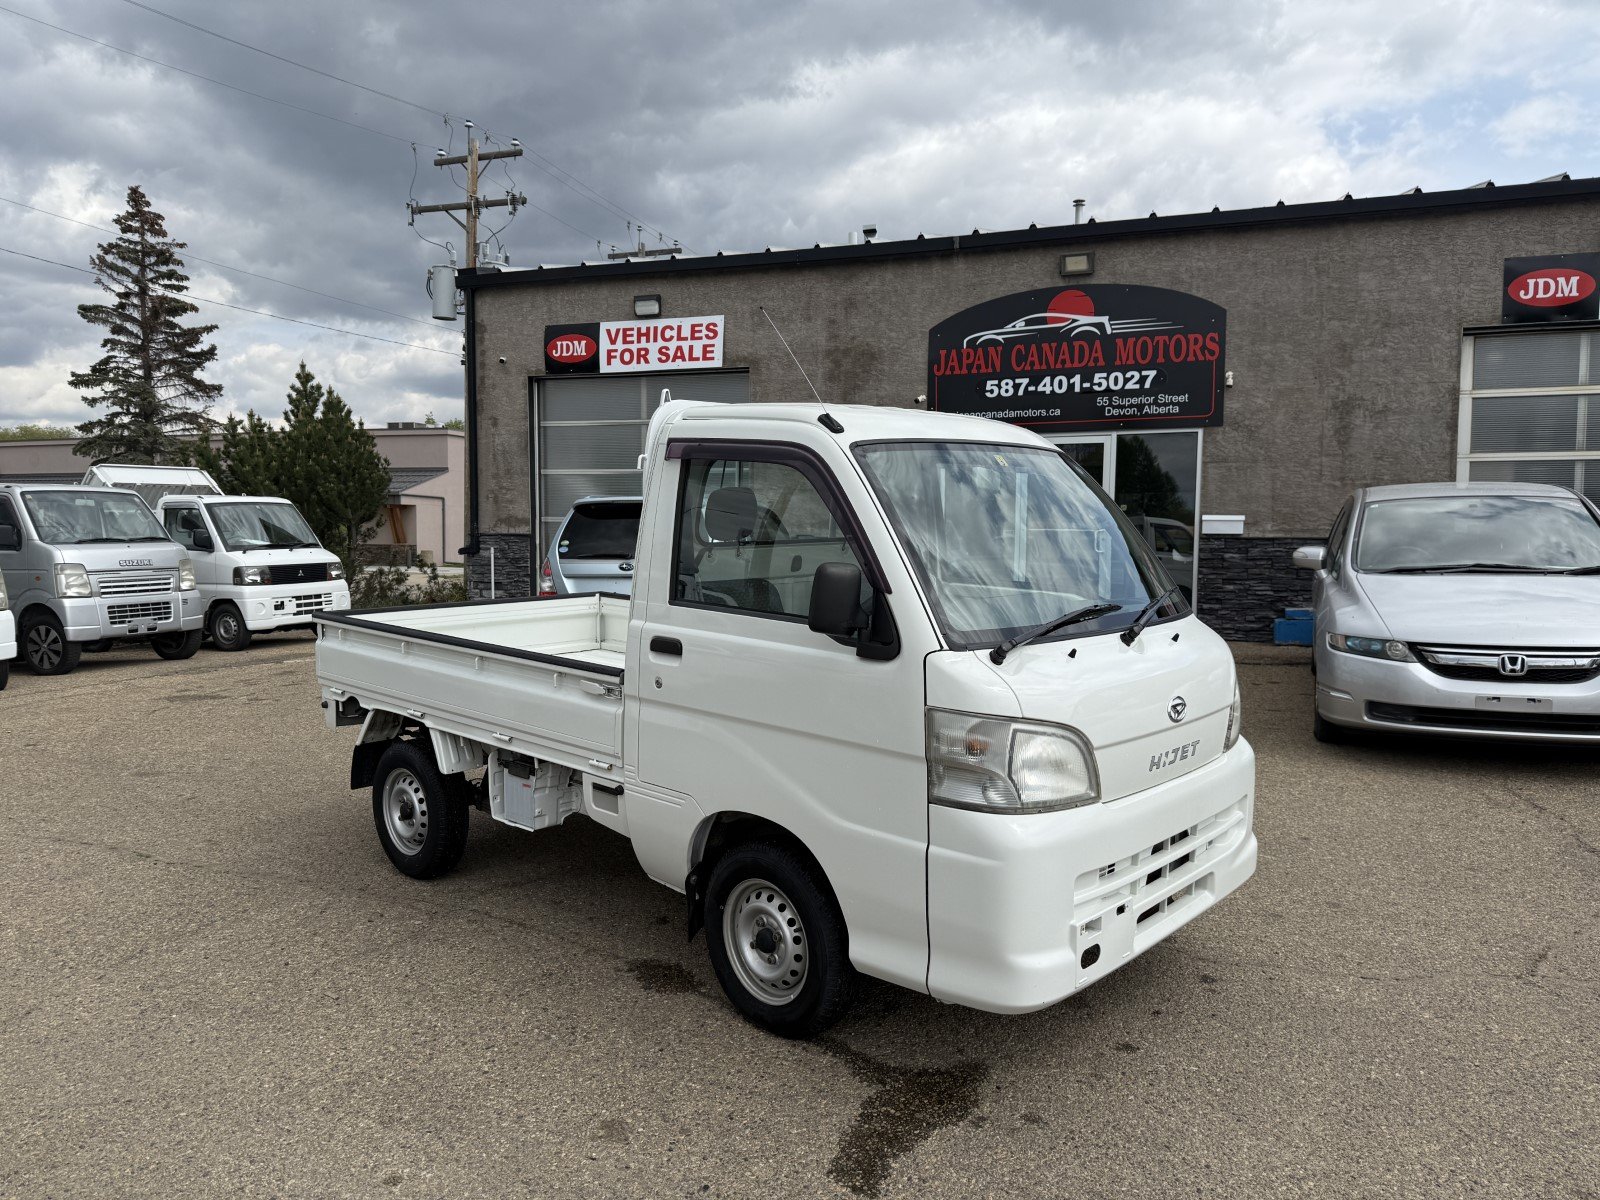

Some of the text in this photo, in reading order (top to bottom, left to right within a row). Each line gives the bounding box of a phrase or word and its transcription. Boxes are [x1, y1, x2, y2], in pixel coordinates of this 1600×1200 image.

[1519, 276, 1580, 300] JDM
[605, 322, 719, 346] VEHICLES
[552, 340, 587, 357] JDM
[606, 344, 715, 366] FOR SALE
[933, 332, 1220, 376] JAPAN CANADA MOTORS
[985, 370, 1157, 398] 587-401-5027
[1096, 393, 1189, 407] 55 Superior Street
[1105, 404, 1180, 416] Devon, Alberta
[118, 559, 154, 567] SUZUKI
